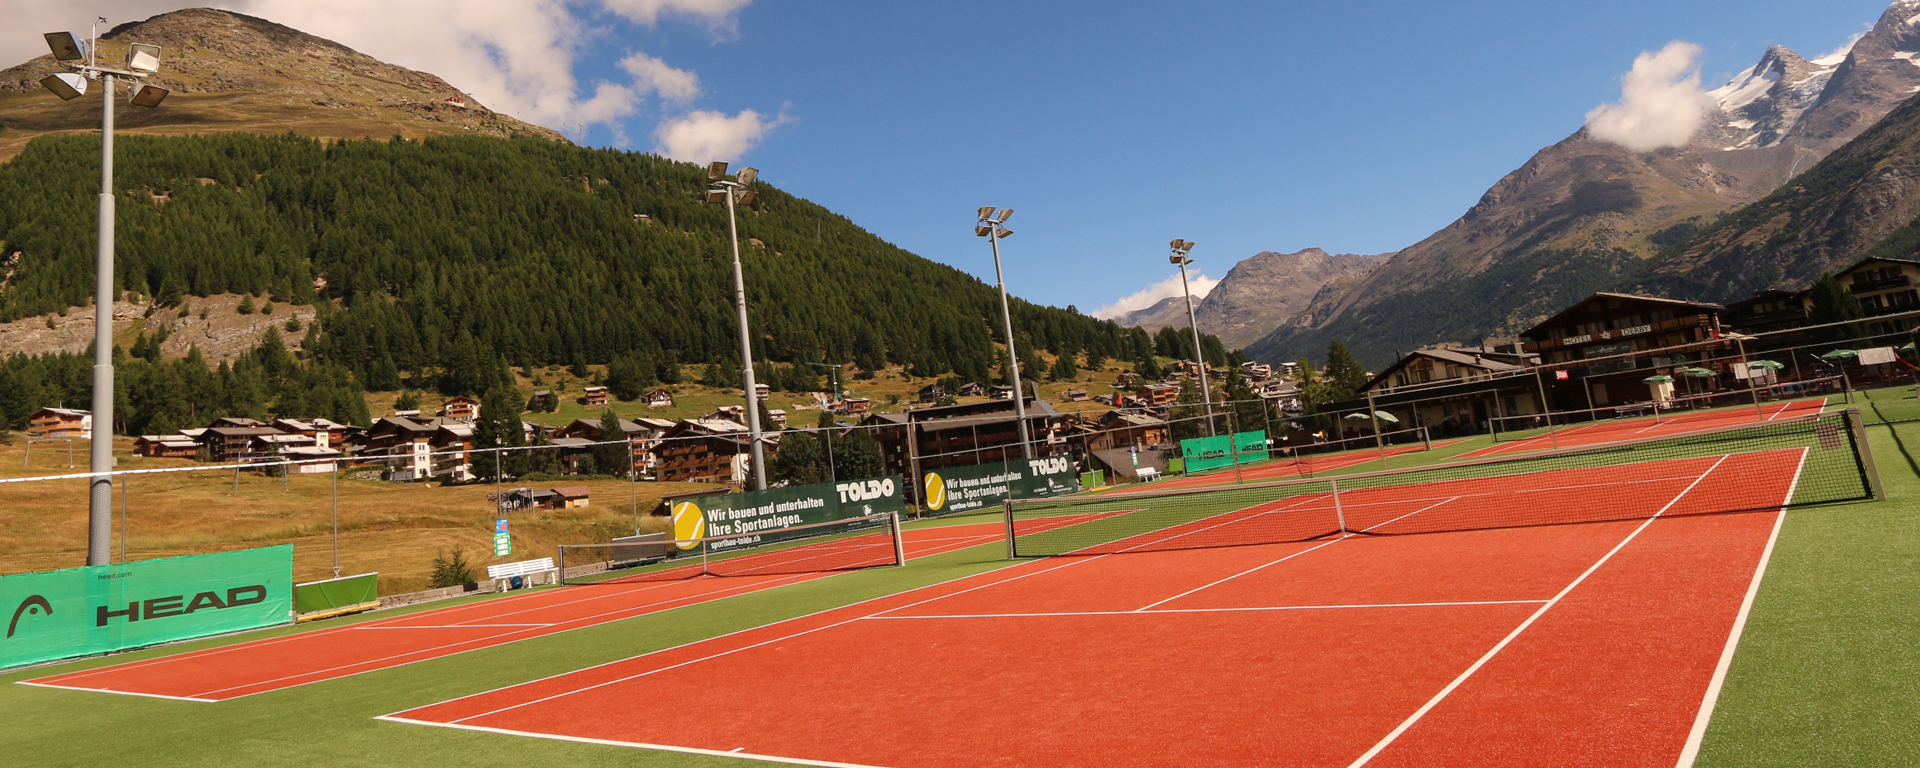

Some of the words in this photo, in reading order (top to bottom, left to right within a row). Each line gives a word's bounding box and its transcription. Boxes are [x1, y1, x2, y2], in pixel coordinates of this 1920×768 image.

[1565, 336, 1591, 345] HOTEL
[1623, 325, 1649, 335] DERBY
[1198, 450, 1225, 460] HEAD
[1242, 444, 1263, 453] HEAD
[1029, 457, 1068, 476] TOLDO
[836, 478, 895, 503] TOLDO
[946, 479, 959, 489] Wir
[959, 476, 979, 488] bauen
[980, 474, 991, 485] und
[947, 489, 962, 501] Ihre
[963, 484, 1009, 500] Sportanlagen.
[707, 509, 727, 522] Wir
[728, 505, 757, 520] bauen
[758, 502, 774, 516] und
[776, 498, 824, 513] unterhalten
[709, 522, 732, 537] Ihre
[734, 513, 803, 535] Sportanlagen.
[97, 571, 132, 580] head.com
[96, 584, 267, 627] HEAD
